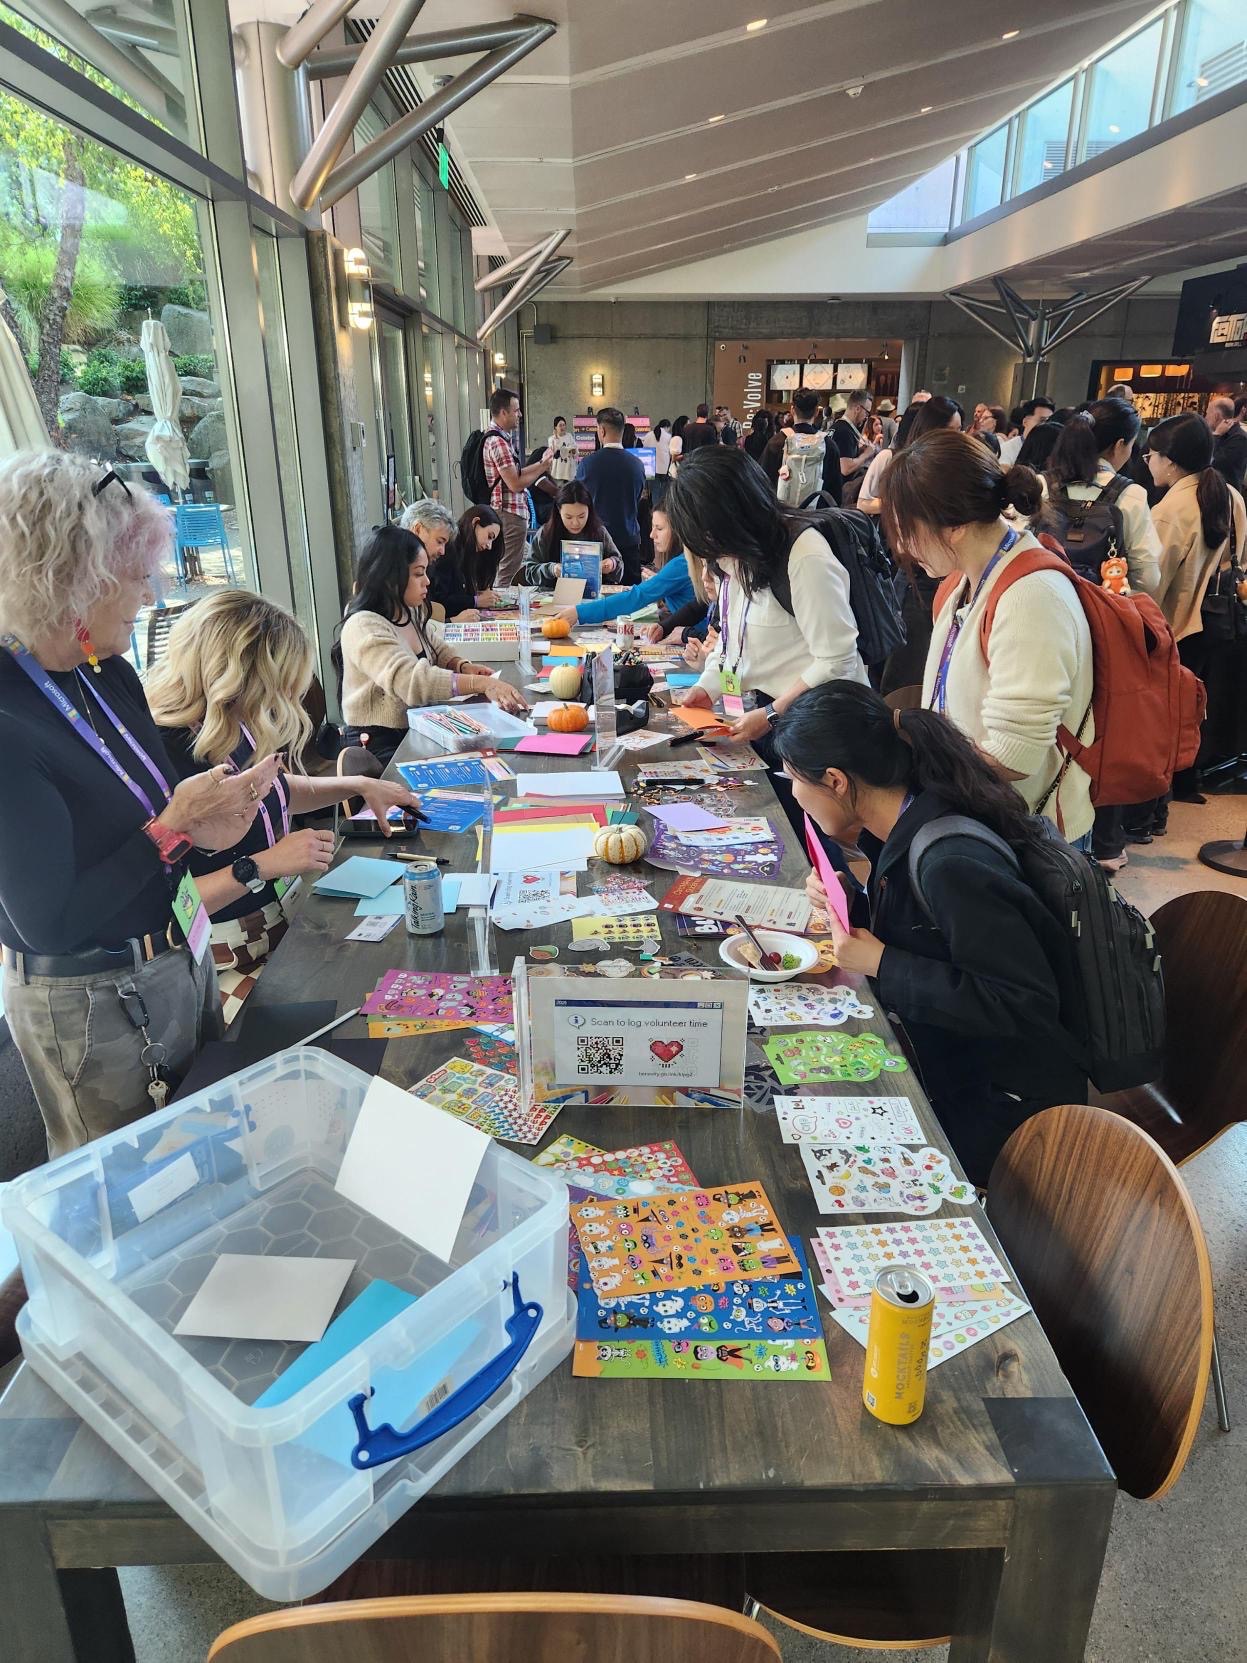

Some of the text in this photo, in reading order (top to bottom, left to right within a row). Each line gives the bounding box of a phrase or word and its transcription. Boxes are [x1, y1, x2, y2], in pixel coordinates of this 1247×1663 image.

[44, 680, 71, 713] Microsoft
[591, 1018, 708, 1028] Scan to log volunteer time
[895, 1332, 910, 1401] MOCKTAILS
